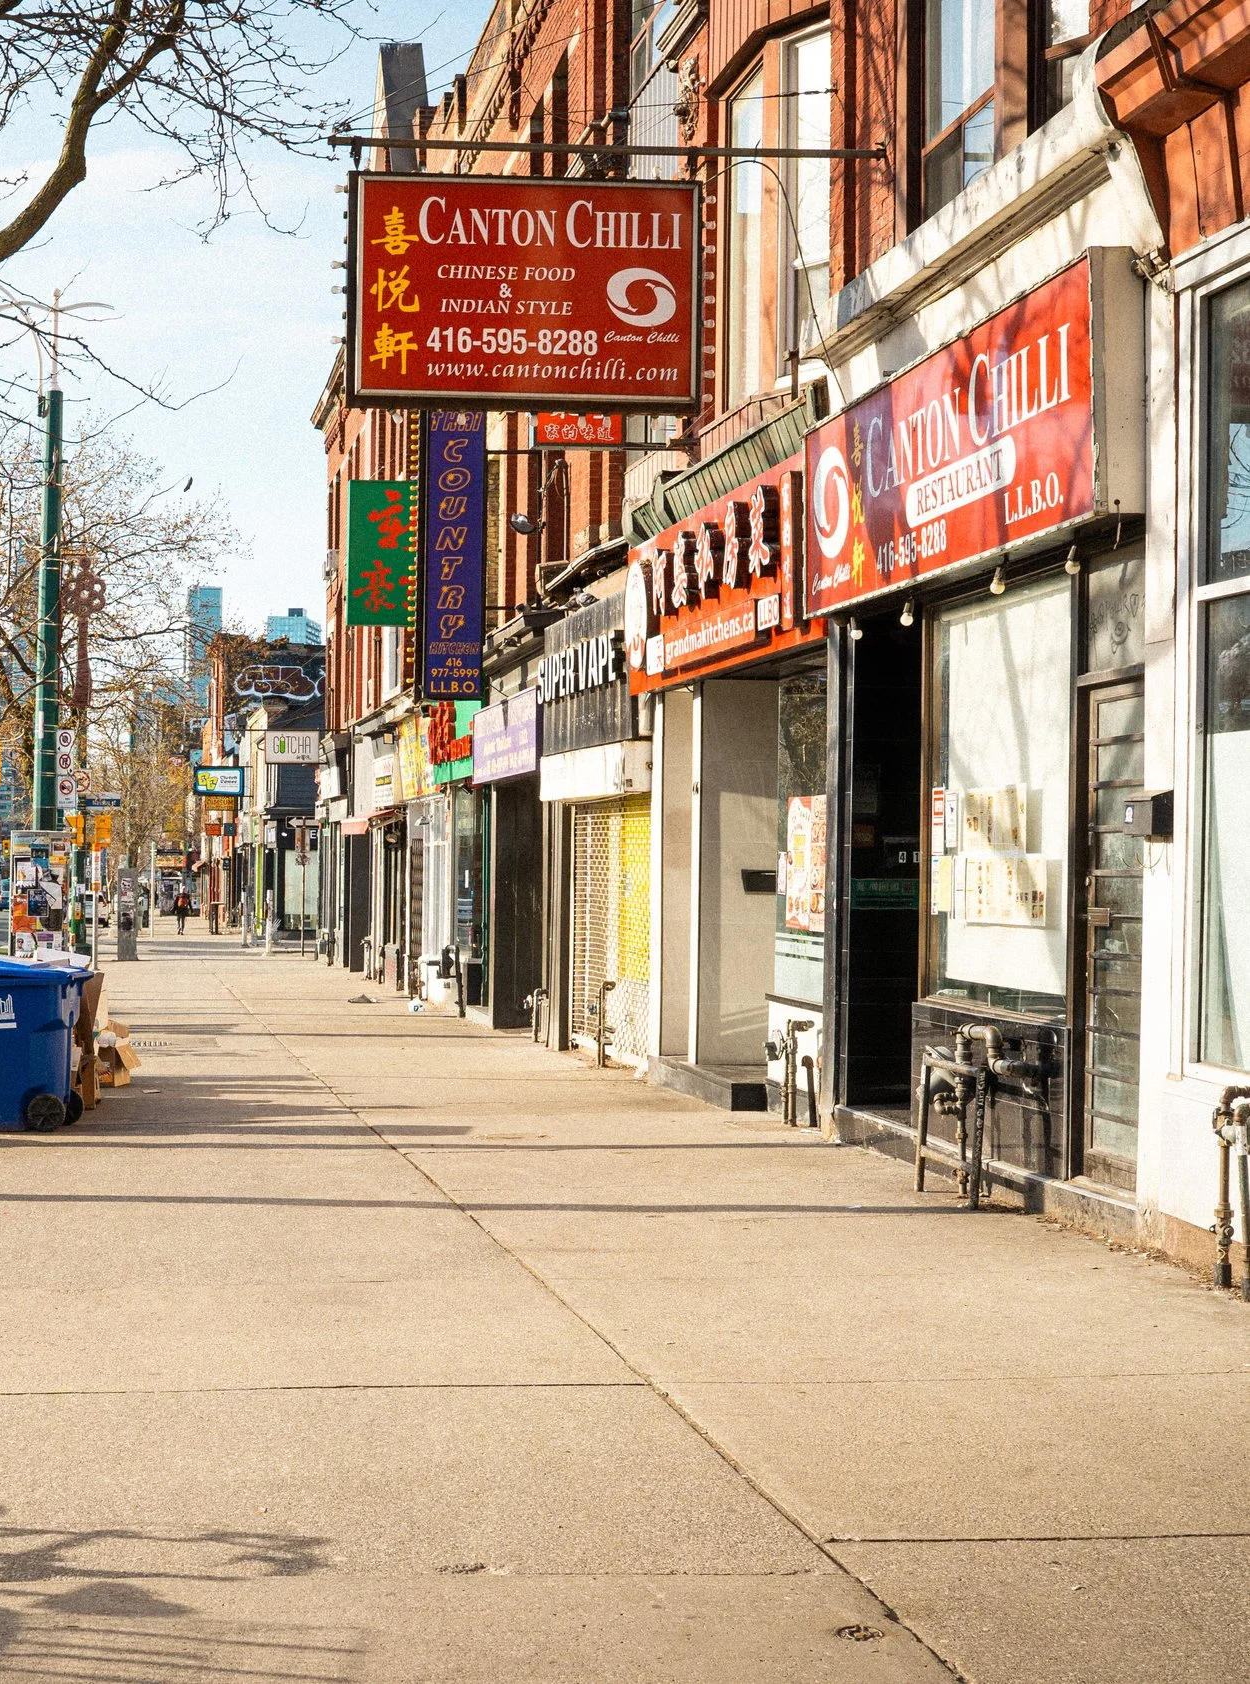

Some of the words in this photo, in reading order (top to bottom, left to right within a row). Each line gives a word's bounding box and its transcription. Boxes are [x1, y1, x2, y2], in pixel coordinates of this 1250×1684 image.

[418, 196, 558, 247] CANTON
[565, 200, 682, 250] CHILLI
[436, 264, 519, 281] CHINESE
[523, 266, 576, 282] FOOD
[499, 283, 512, 298] &
[440, 299, 511, 315] INDIAN
[515, 300, 573, 316] STYLE
[426, 326, 598, 356] 416-595-8288
[604, 331, 644, 344] Canton
[646, 331, 681, 344] Chilli
[426, 358, 679, 382] www.cantonchilli.com
[866, 386, 961, 498] CANTON
[968, 322, 1071, 447] CHILLI
[430, 412, 483, 431] THAI
[916, 449, 1004, 517] RESTAURANT
[1004, 471, 1064, 525] L.L.B.O.
[435, 439, 471, 638] COUNTRY
[875, 522, 947, 575] 416-595-8288
[429, 642, 480, 655] KITCHEN
[665, 611, 754, 665] grandmakitchens.ca
[430, 668, 480, 678] 977-5999
[445, 658, 462, 667] 416
[536, 650, 575, 705] SUPER
[578, 631, 616, 690] VAPE
[430, 681, 479, 693] L.L.B.O.
[273, 734, 311, 754] GOTCHA
